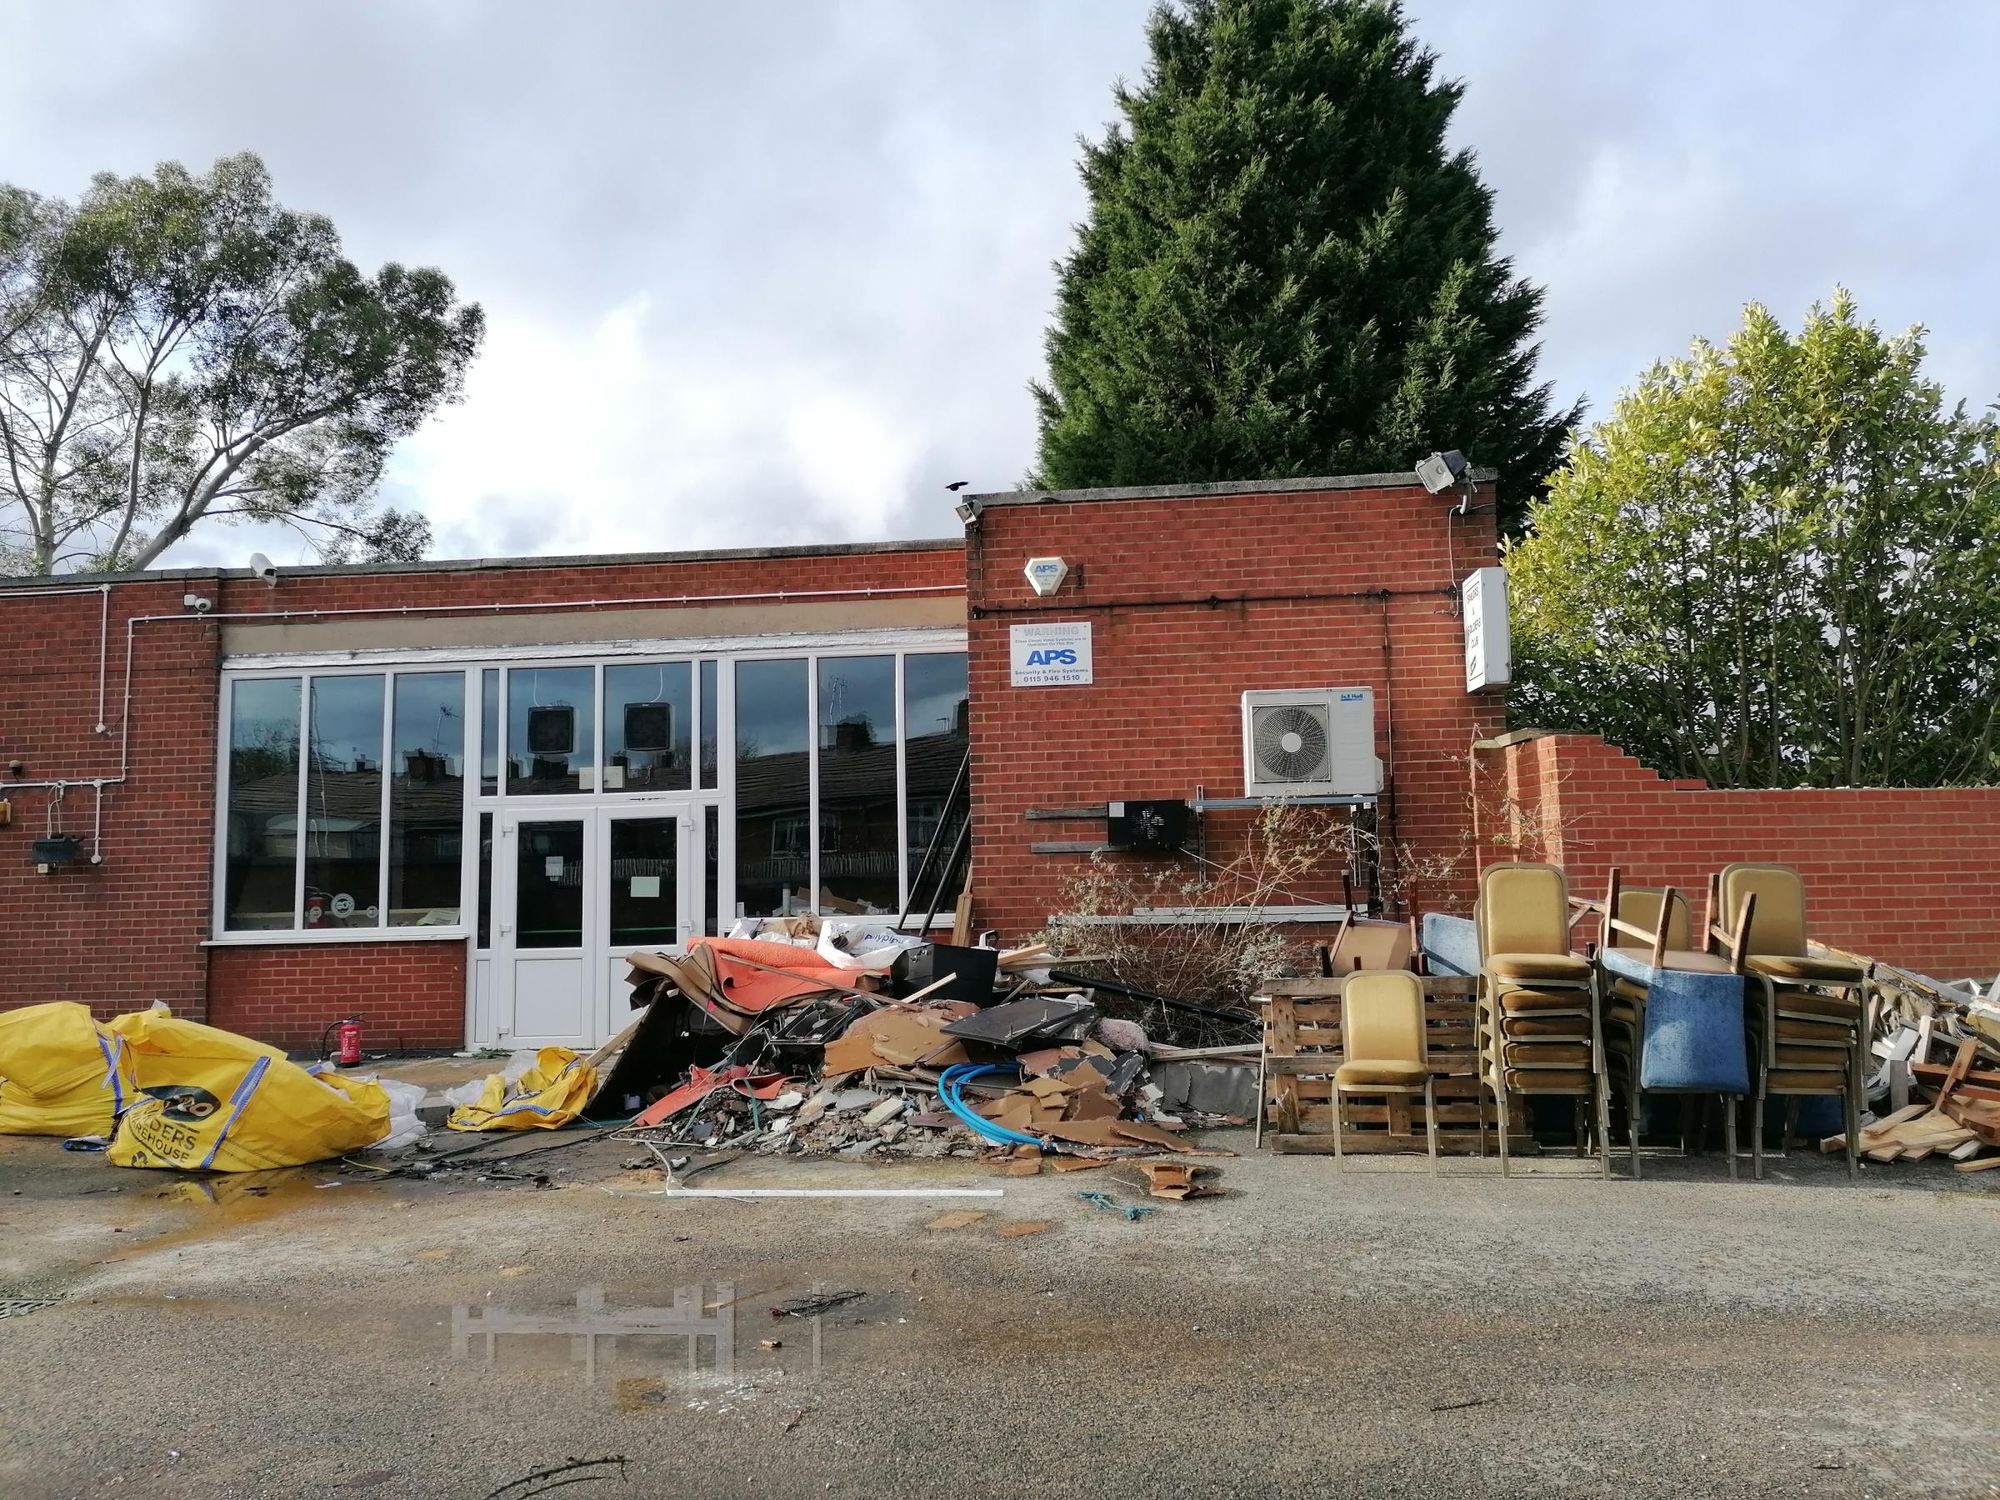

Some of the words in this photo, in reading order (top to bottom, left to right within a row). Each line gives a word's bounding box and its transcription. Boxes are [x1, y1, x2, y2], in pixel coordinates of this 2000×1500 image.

[1035, 564, 1058, 572] APS
[1024, 627, 1079, 636] WARNING
[1026, 649, 1077, 666] APS
[131, 1118, 190, 1164] AREHOUSE
